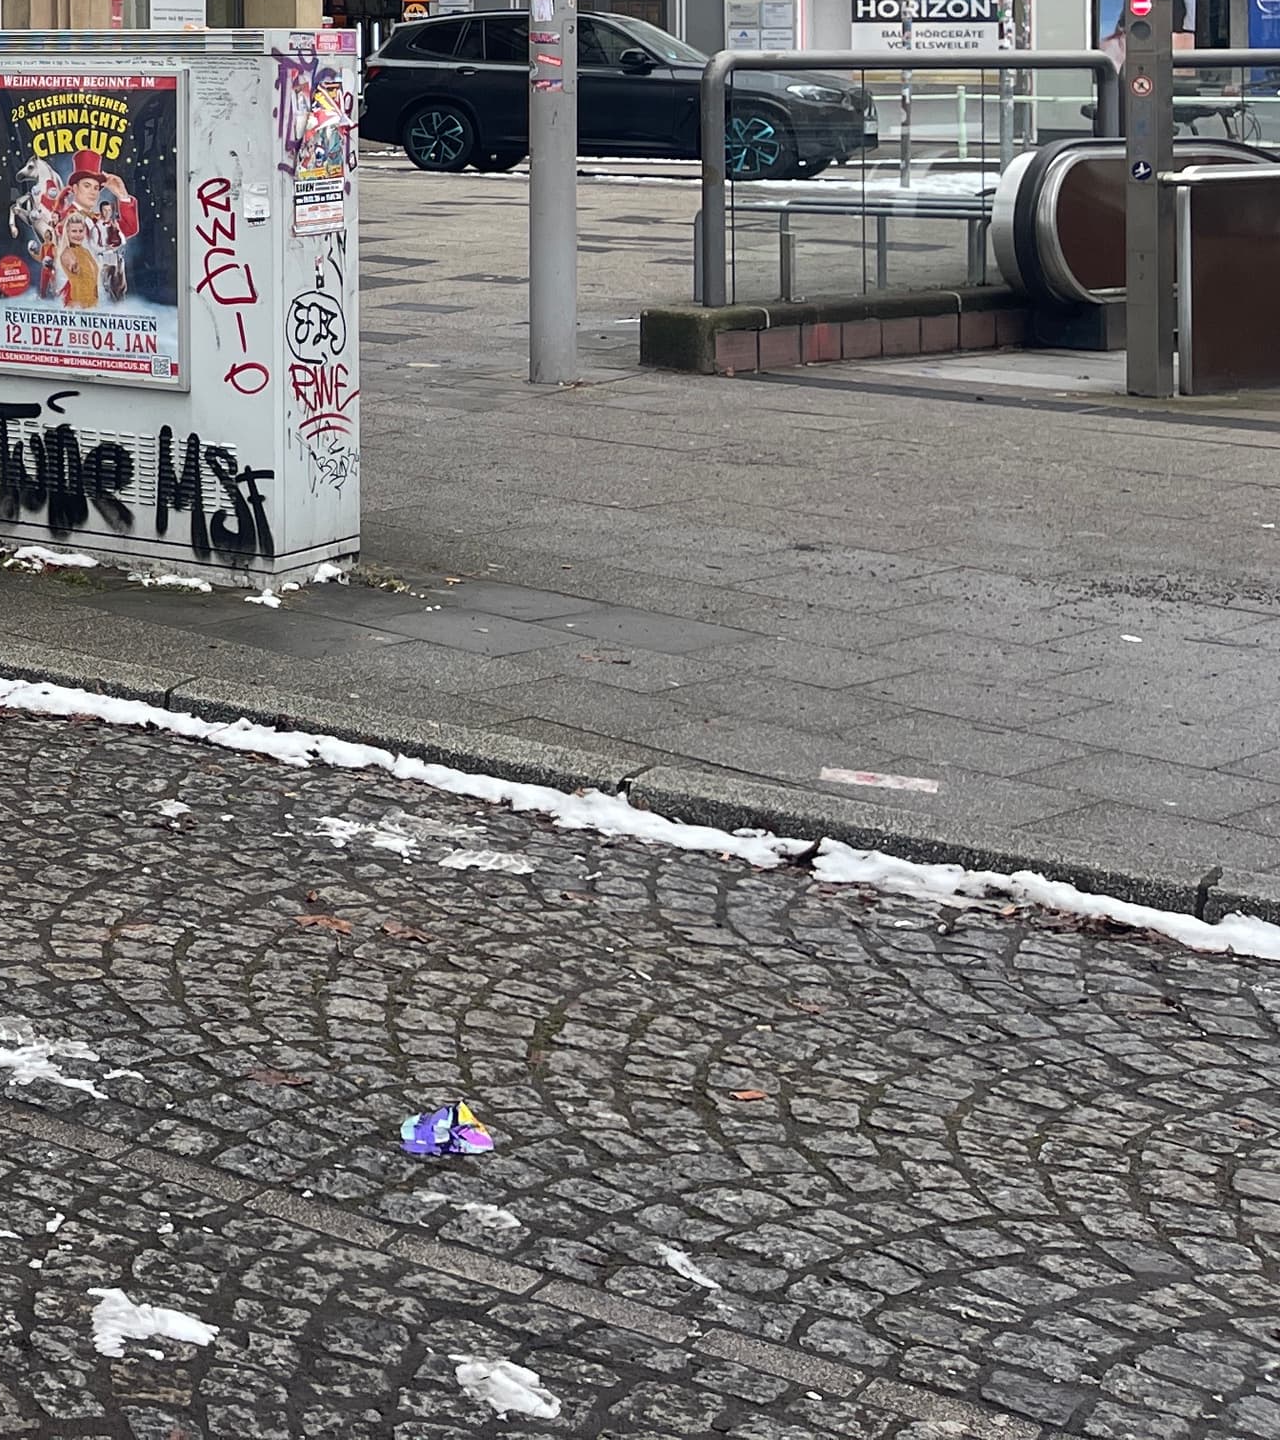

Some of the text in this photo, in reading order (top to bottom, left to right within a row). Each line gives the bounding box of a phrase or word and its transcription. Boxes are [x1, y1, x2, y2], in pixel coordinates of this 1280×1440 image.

[915, 28, 985, 39] HÖRGERÄTE
[3, 76, 80, 87] WEIHNACHTEN
[141, 76, 155, 87] IM
[26, 109, 128, 134] WEIHNACHTS
[32, 128, 123, 160] CIRCUS
[5, 311, 77, 327] REVIERPARK
[80, 316, 157, 332] NIENHAUSEN
[6, 324, 27, 344] 12.
[31, 326, 63, 346] DEZ
[69, 333, 89, 345] BIS
[92, 331, 121, 351] 04.
[125, 333, 157, 353] JAN
